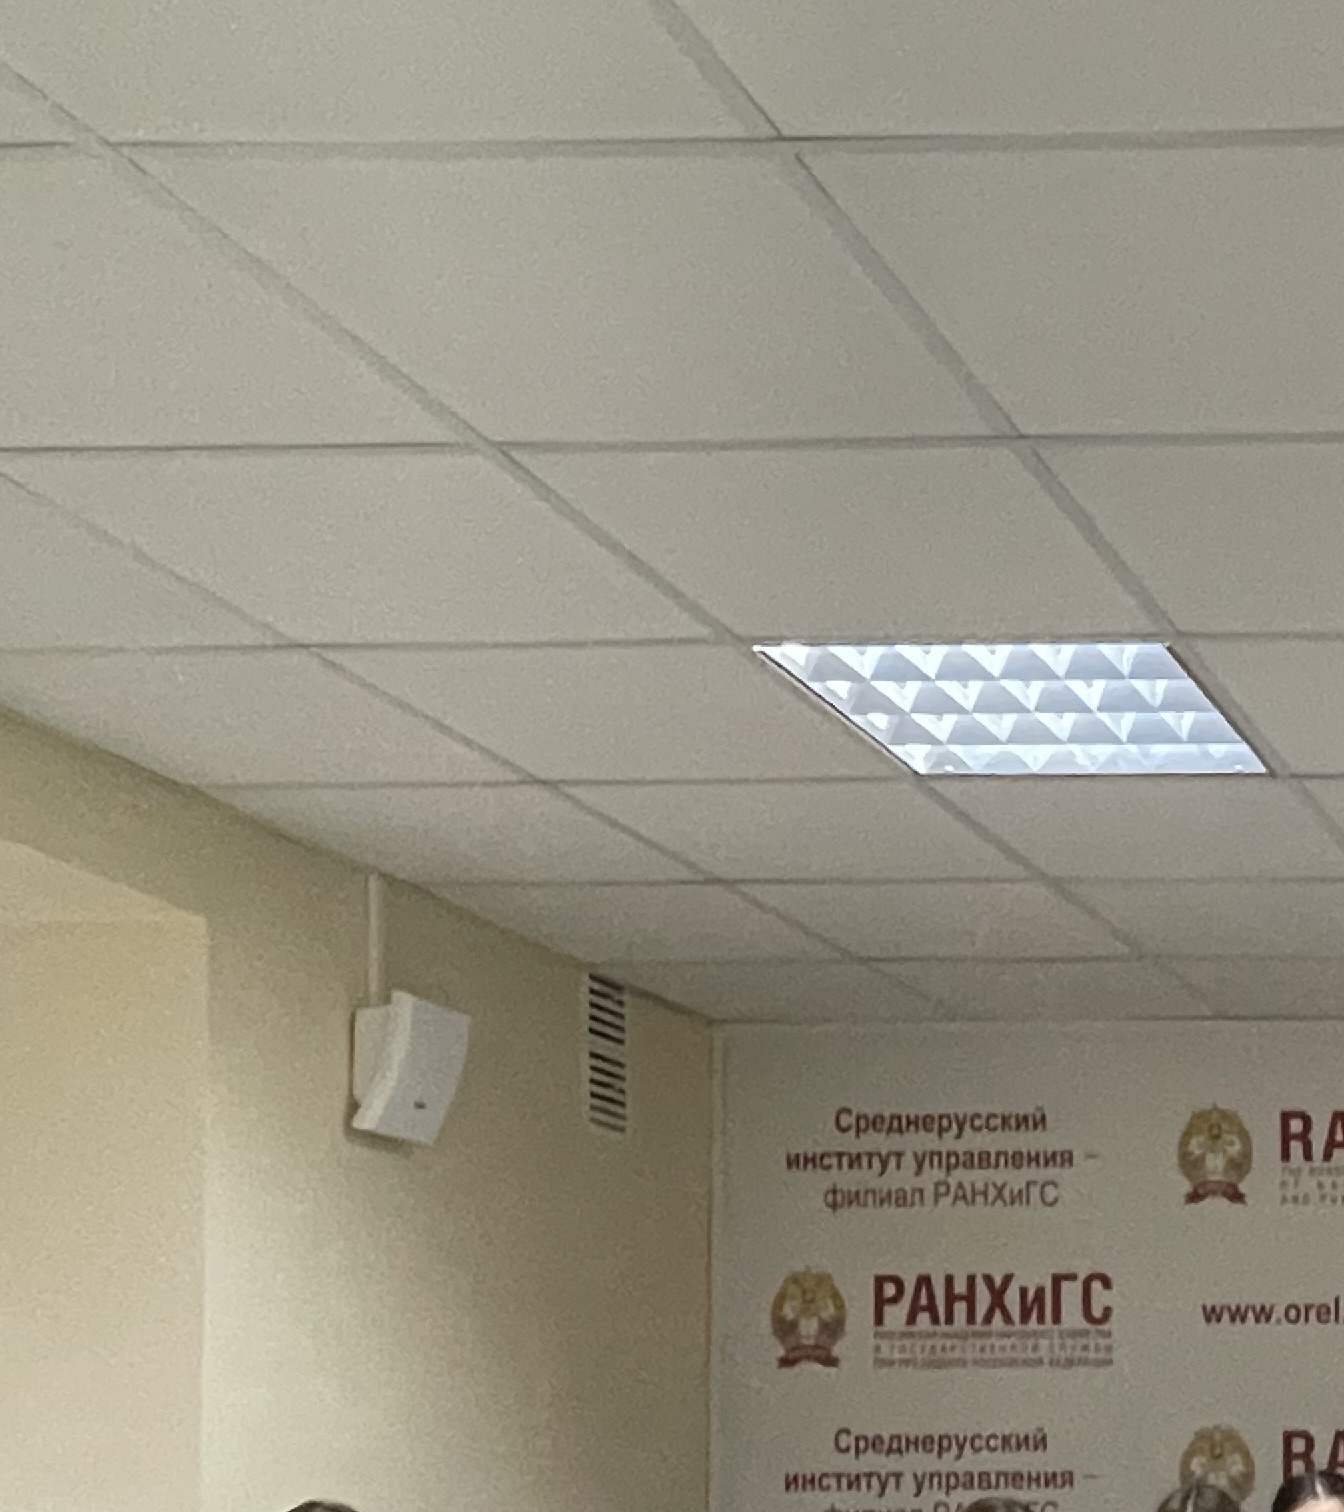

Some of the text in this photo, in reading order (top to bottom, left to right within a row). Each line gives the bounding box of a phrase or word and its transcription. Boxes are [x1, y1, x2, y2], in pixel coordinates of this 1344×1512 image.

[834, 1105, 1047, 1139] Среднерусский
[786, 1150, 904, 1177] институт
[912, 1150, 1074, 1176] управления
[824, 1180, 1059, 1213] филиал РАНХиГС
[873, 1271, 1114, 1327] РАНХиГС
[834, 1427, 1048, 1460] Среднерусский
[784, 1470, 904, 1498] институт
[912, 1470, 1074, 1498] управления
